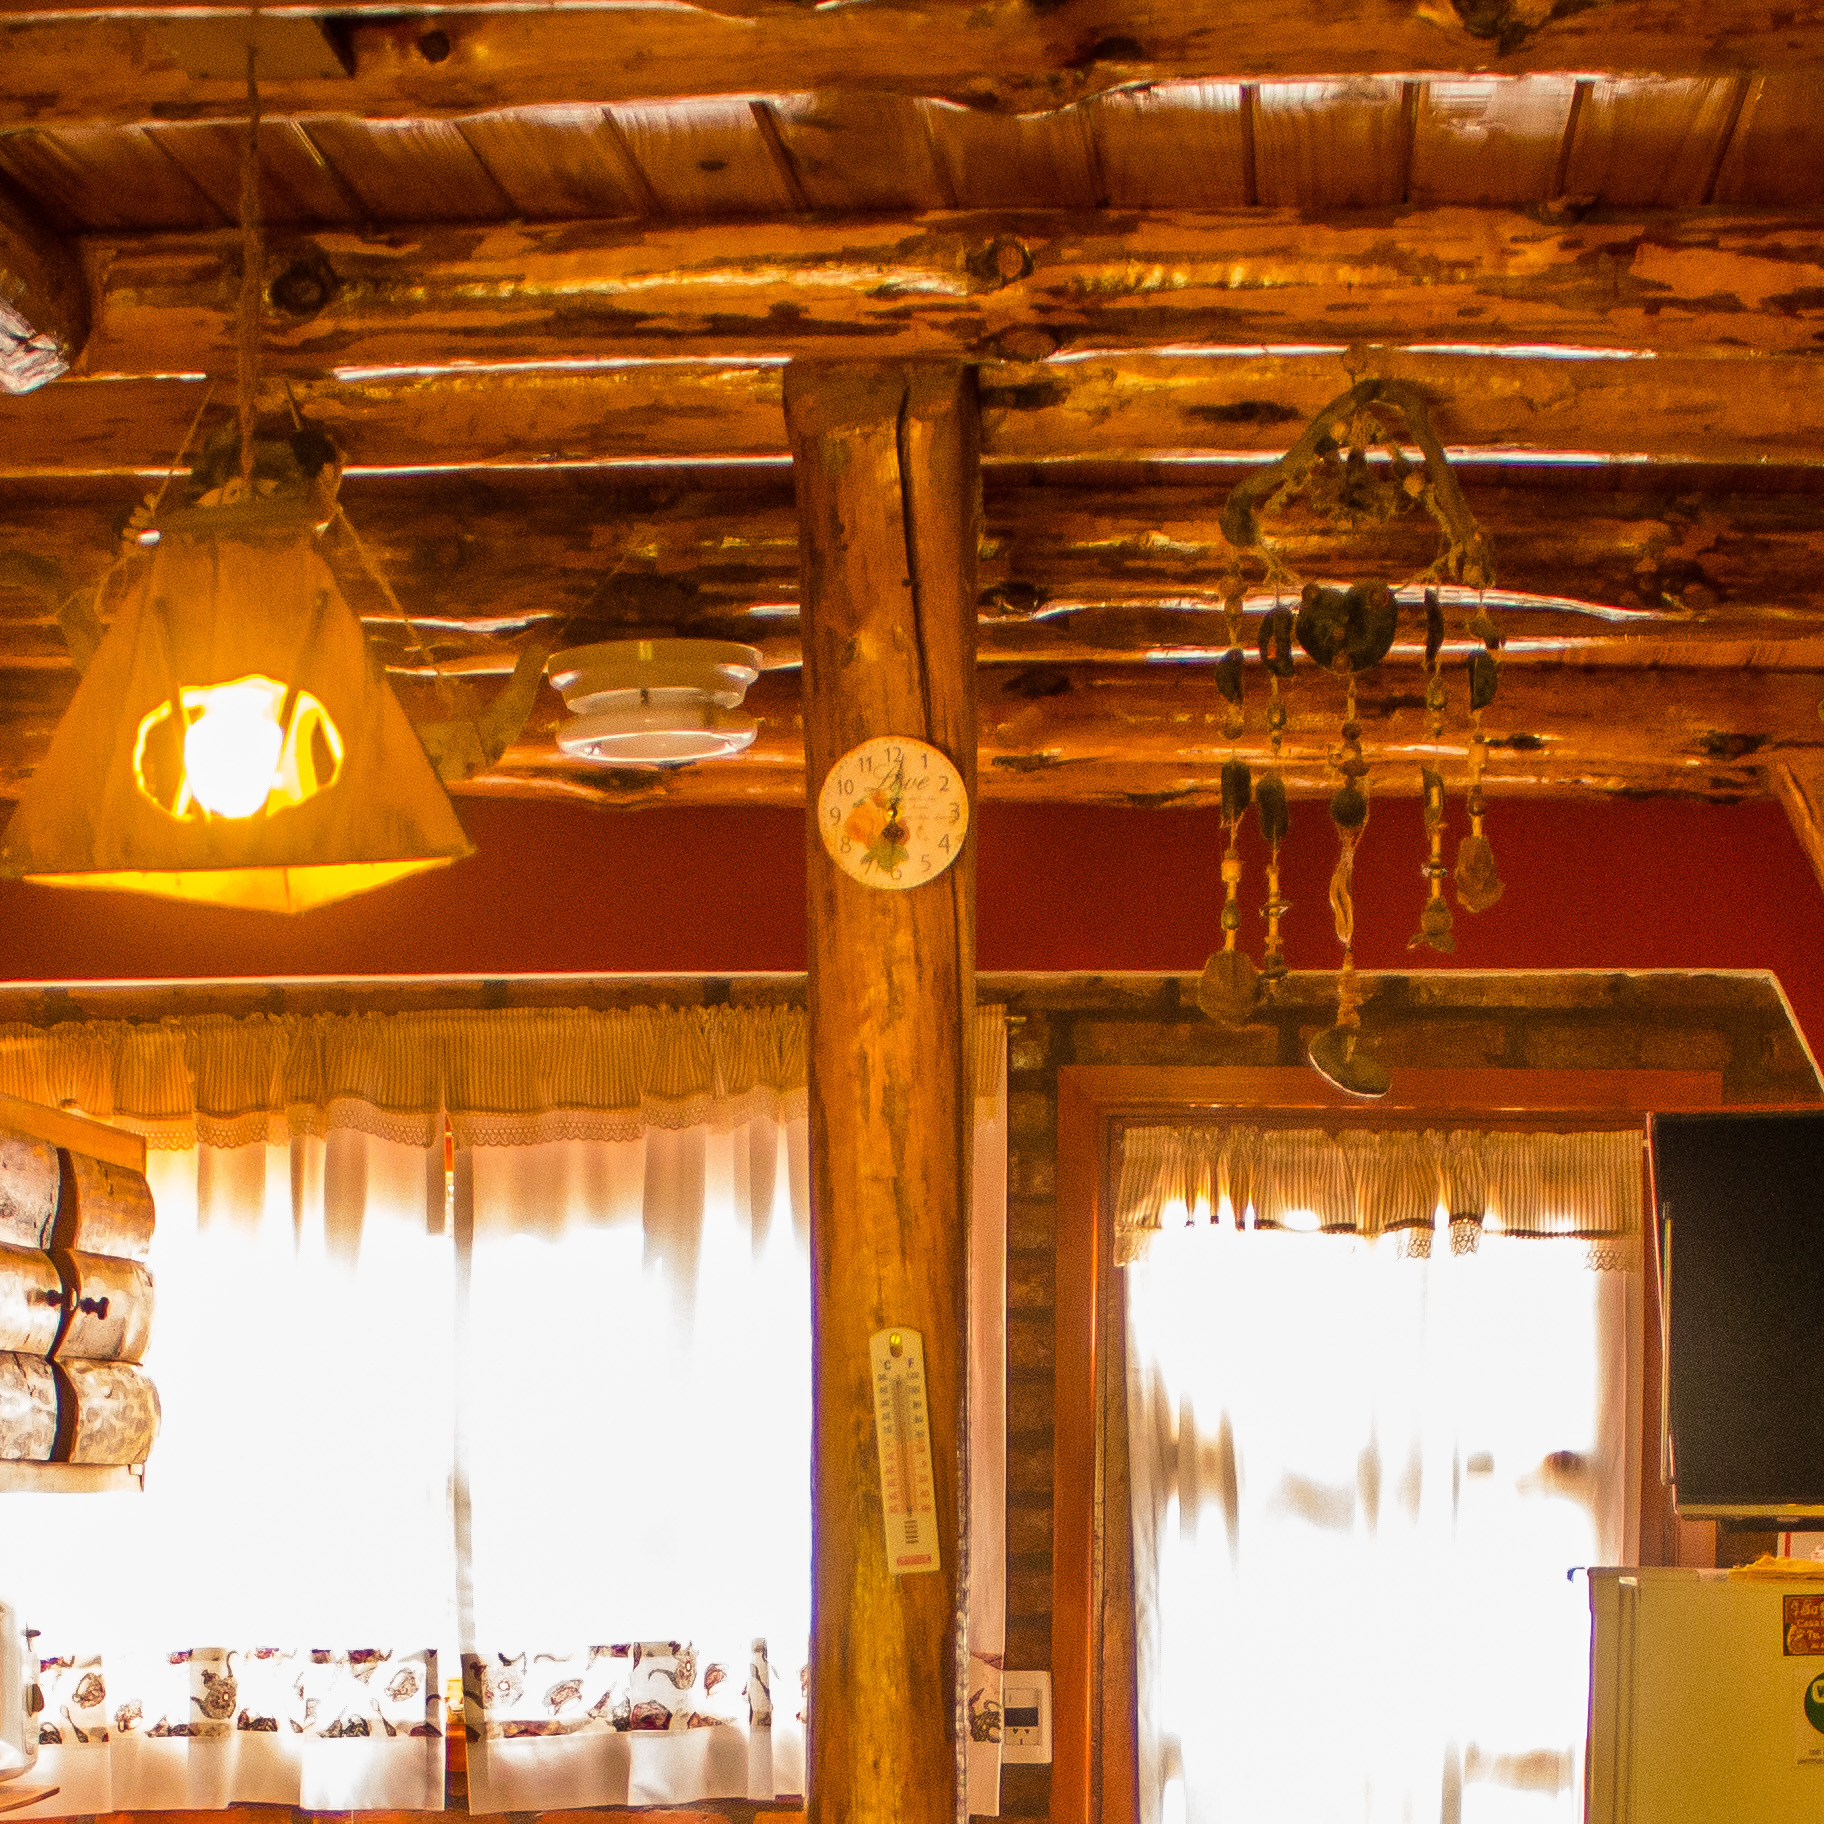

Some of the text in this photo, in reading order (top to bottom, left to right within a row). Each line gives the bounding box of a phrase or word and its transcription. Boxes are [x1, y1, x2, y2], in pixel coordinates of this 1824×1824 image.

[884, 746, 903, 763] 12
[921, 753, 928, 769] 1
[858, 756, 872, 772] 11
[837, 779, 854, 795] 10
[938, 776, 949, 792] 2
[829, 807, 841, 826] 9
[949, 802, 960, 824] 3
[839, 836, 851, 854] 8
[938, 834, 950, 854] 4
[921, 854, 931, 872] 5
[883, 1360, 892, 1371] C
